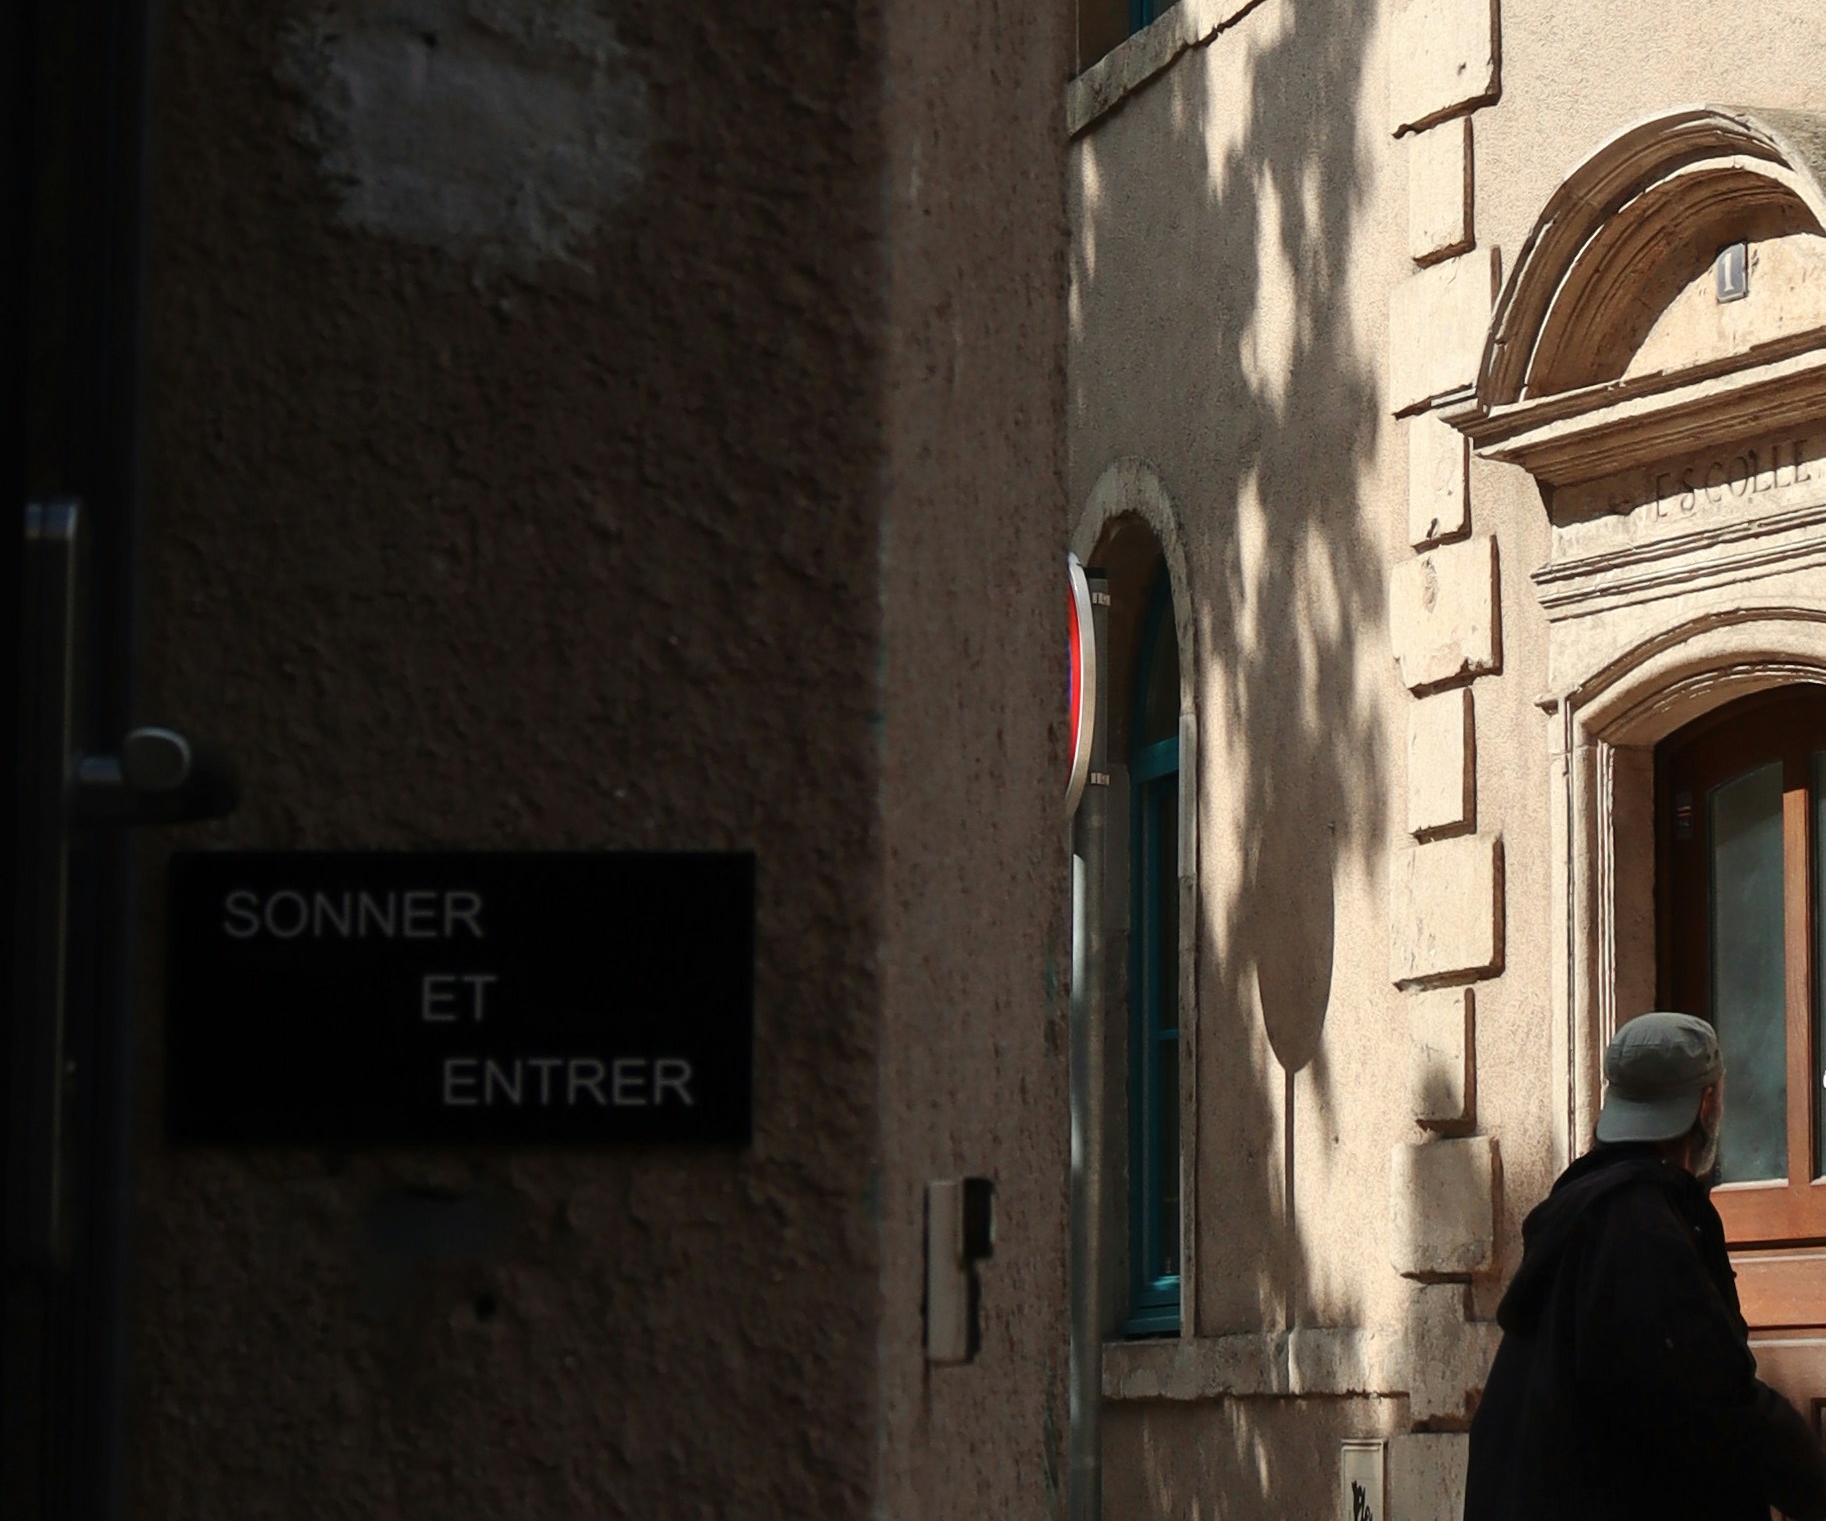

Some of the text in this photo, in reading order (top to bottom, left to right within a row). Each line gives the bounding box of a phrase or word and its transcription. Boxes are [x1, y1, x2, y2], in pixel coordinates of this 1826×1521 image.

[1722, 252, 1735, 292] 1
[222, 890, 484, 938] SONNER
[422, 975, 498, 1021] ET
[442, 1058, 695, 1106] ENTRER
